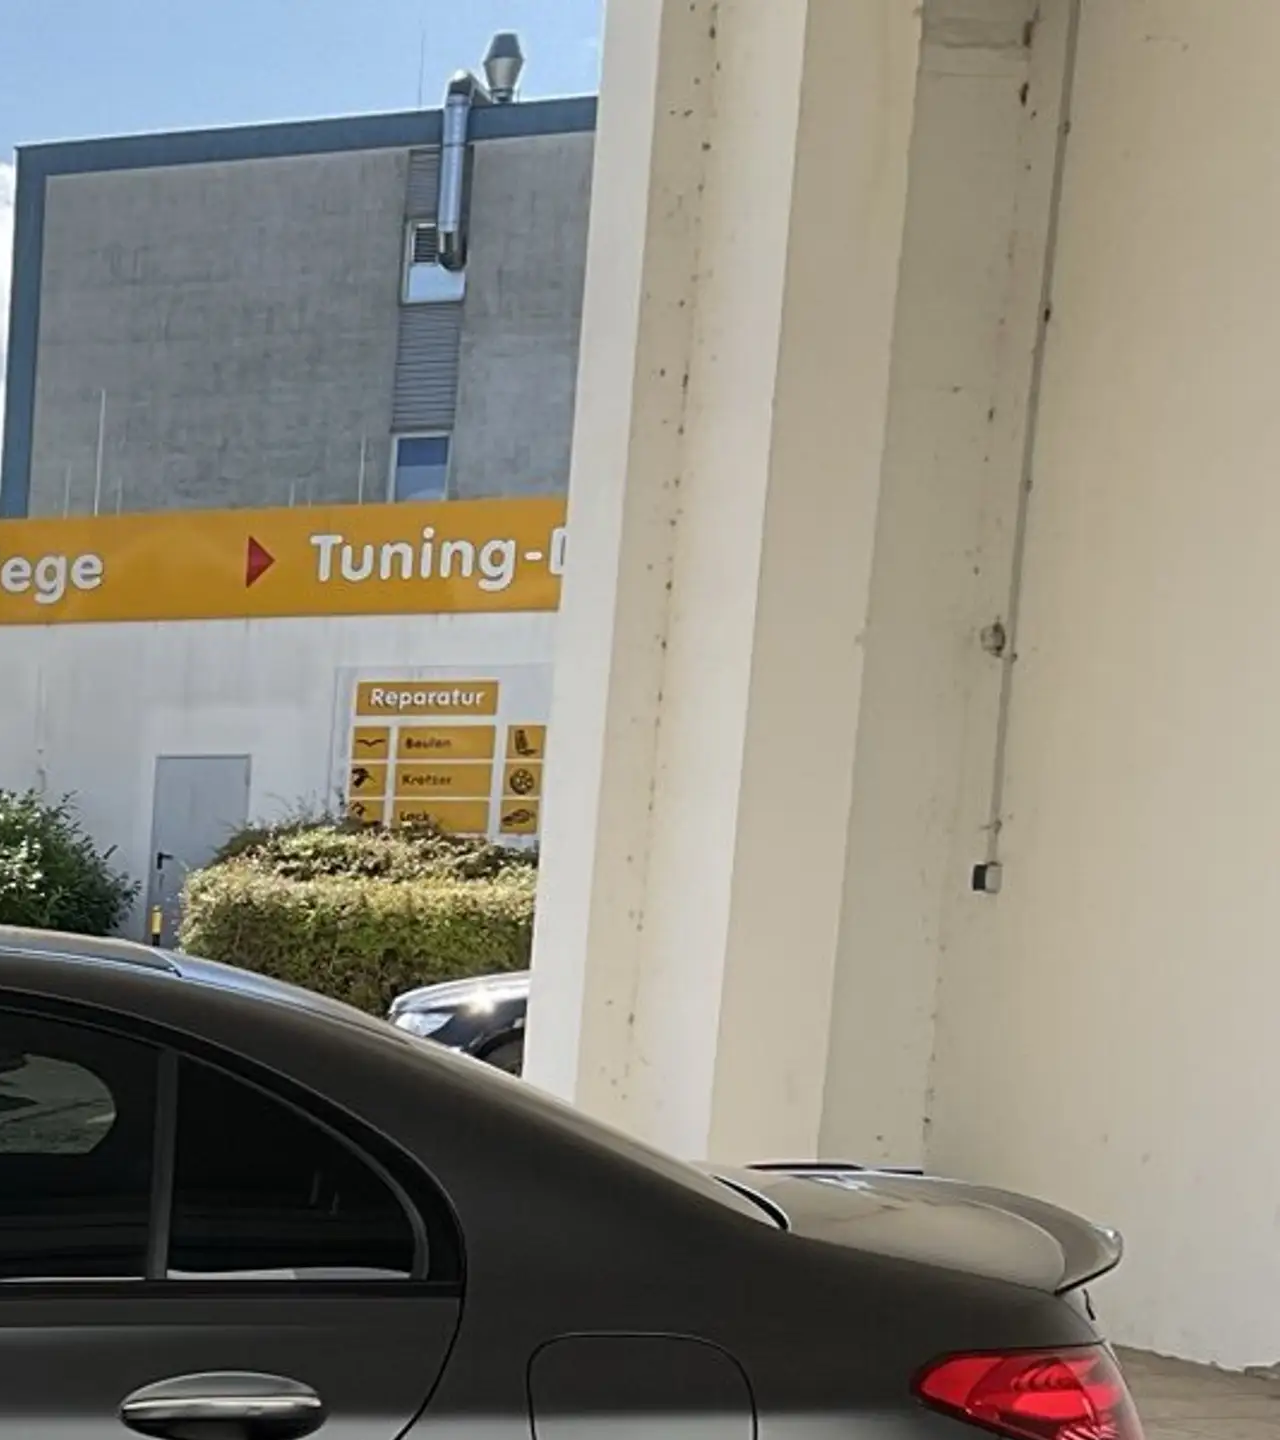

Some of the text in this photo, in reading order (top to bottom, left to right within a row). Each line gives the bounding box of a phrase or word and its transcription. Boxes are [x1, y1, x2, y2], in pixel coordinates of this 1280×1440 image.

[370, 687, 485, 709] Reparatur
[405, 736, 452, 749] Beulen
[401, 773, 453, 787] Kratzer
[399, 811, 430, 823] Lack
